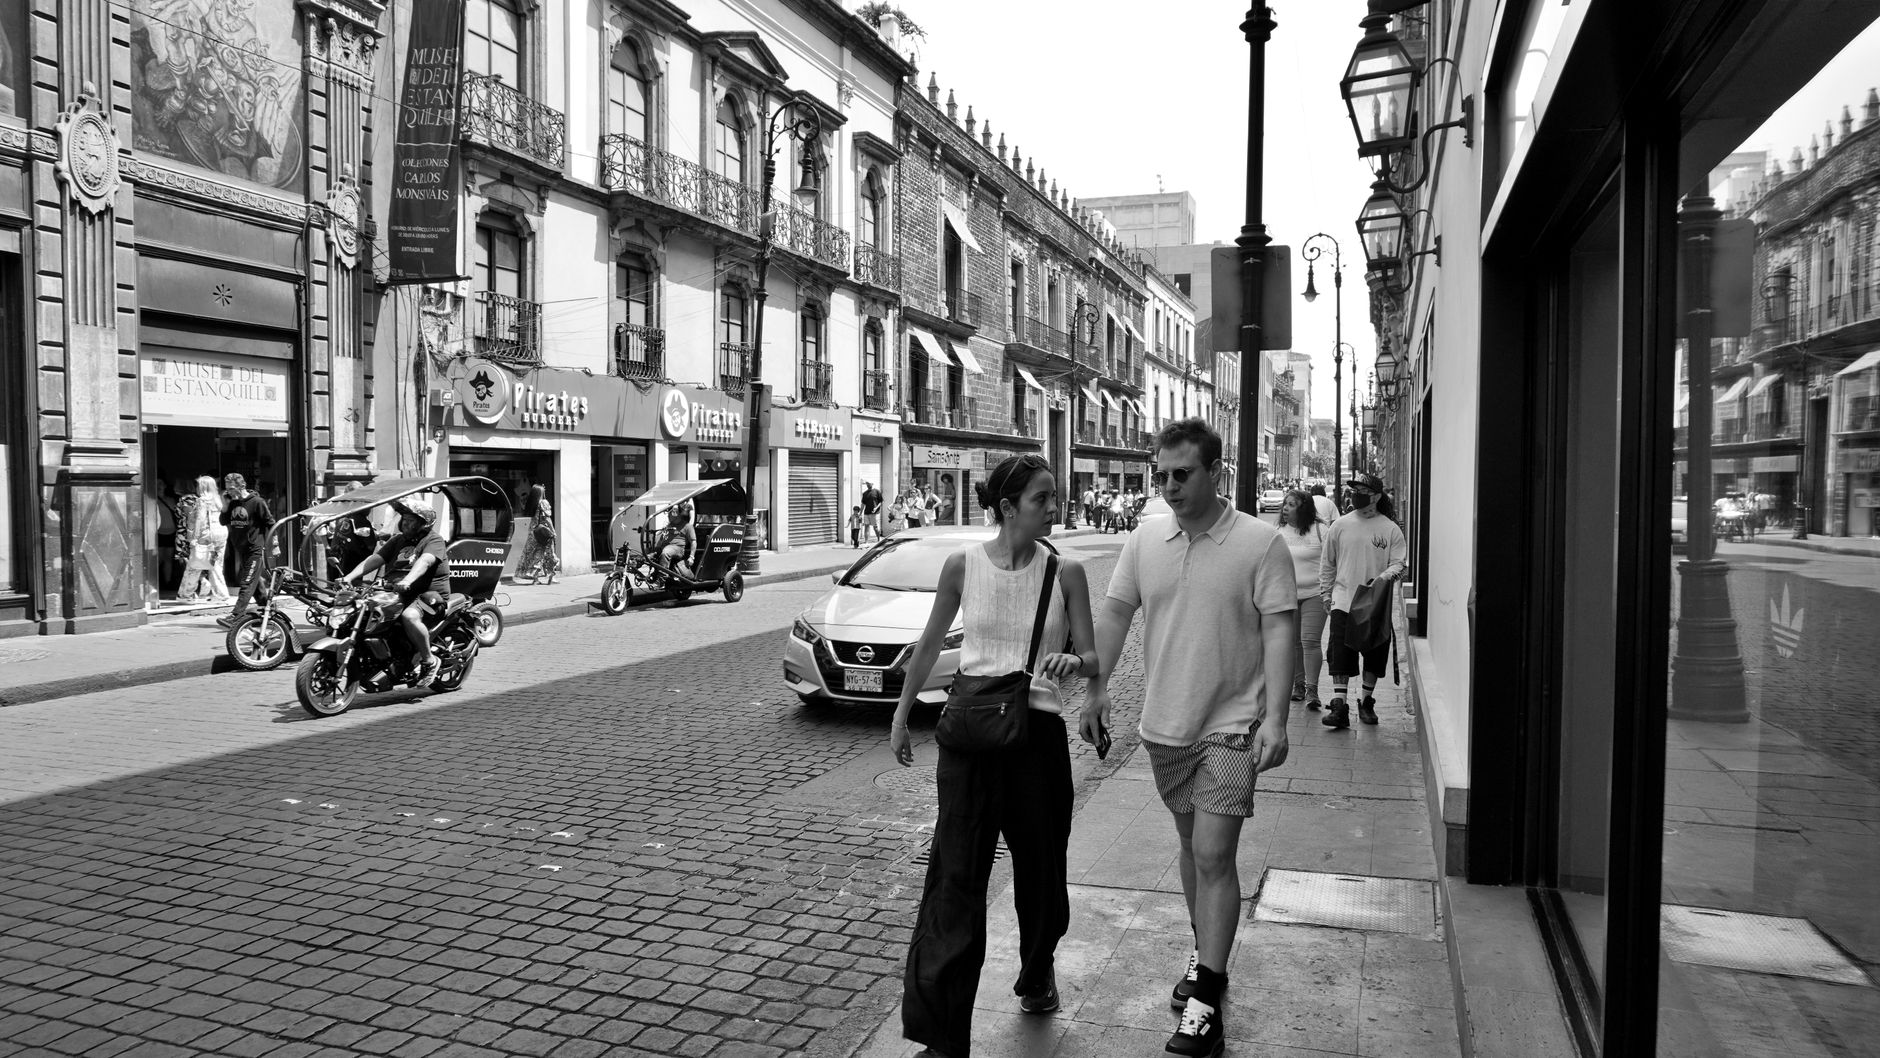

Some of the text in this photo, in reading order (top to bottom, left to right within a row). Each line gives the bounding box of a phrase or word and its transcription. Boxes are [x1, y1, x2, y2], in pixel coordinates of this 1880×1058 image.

[239, 366, 265, 384] DEL
[513, 382, 589, 415] Pirates
[523, 412, 579, 426] BURGERS
[691, 401, 741, 427] Pirates
[697, 427, 734, 438] BURGERS
